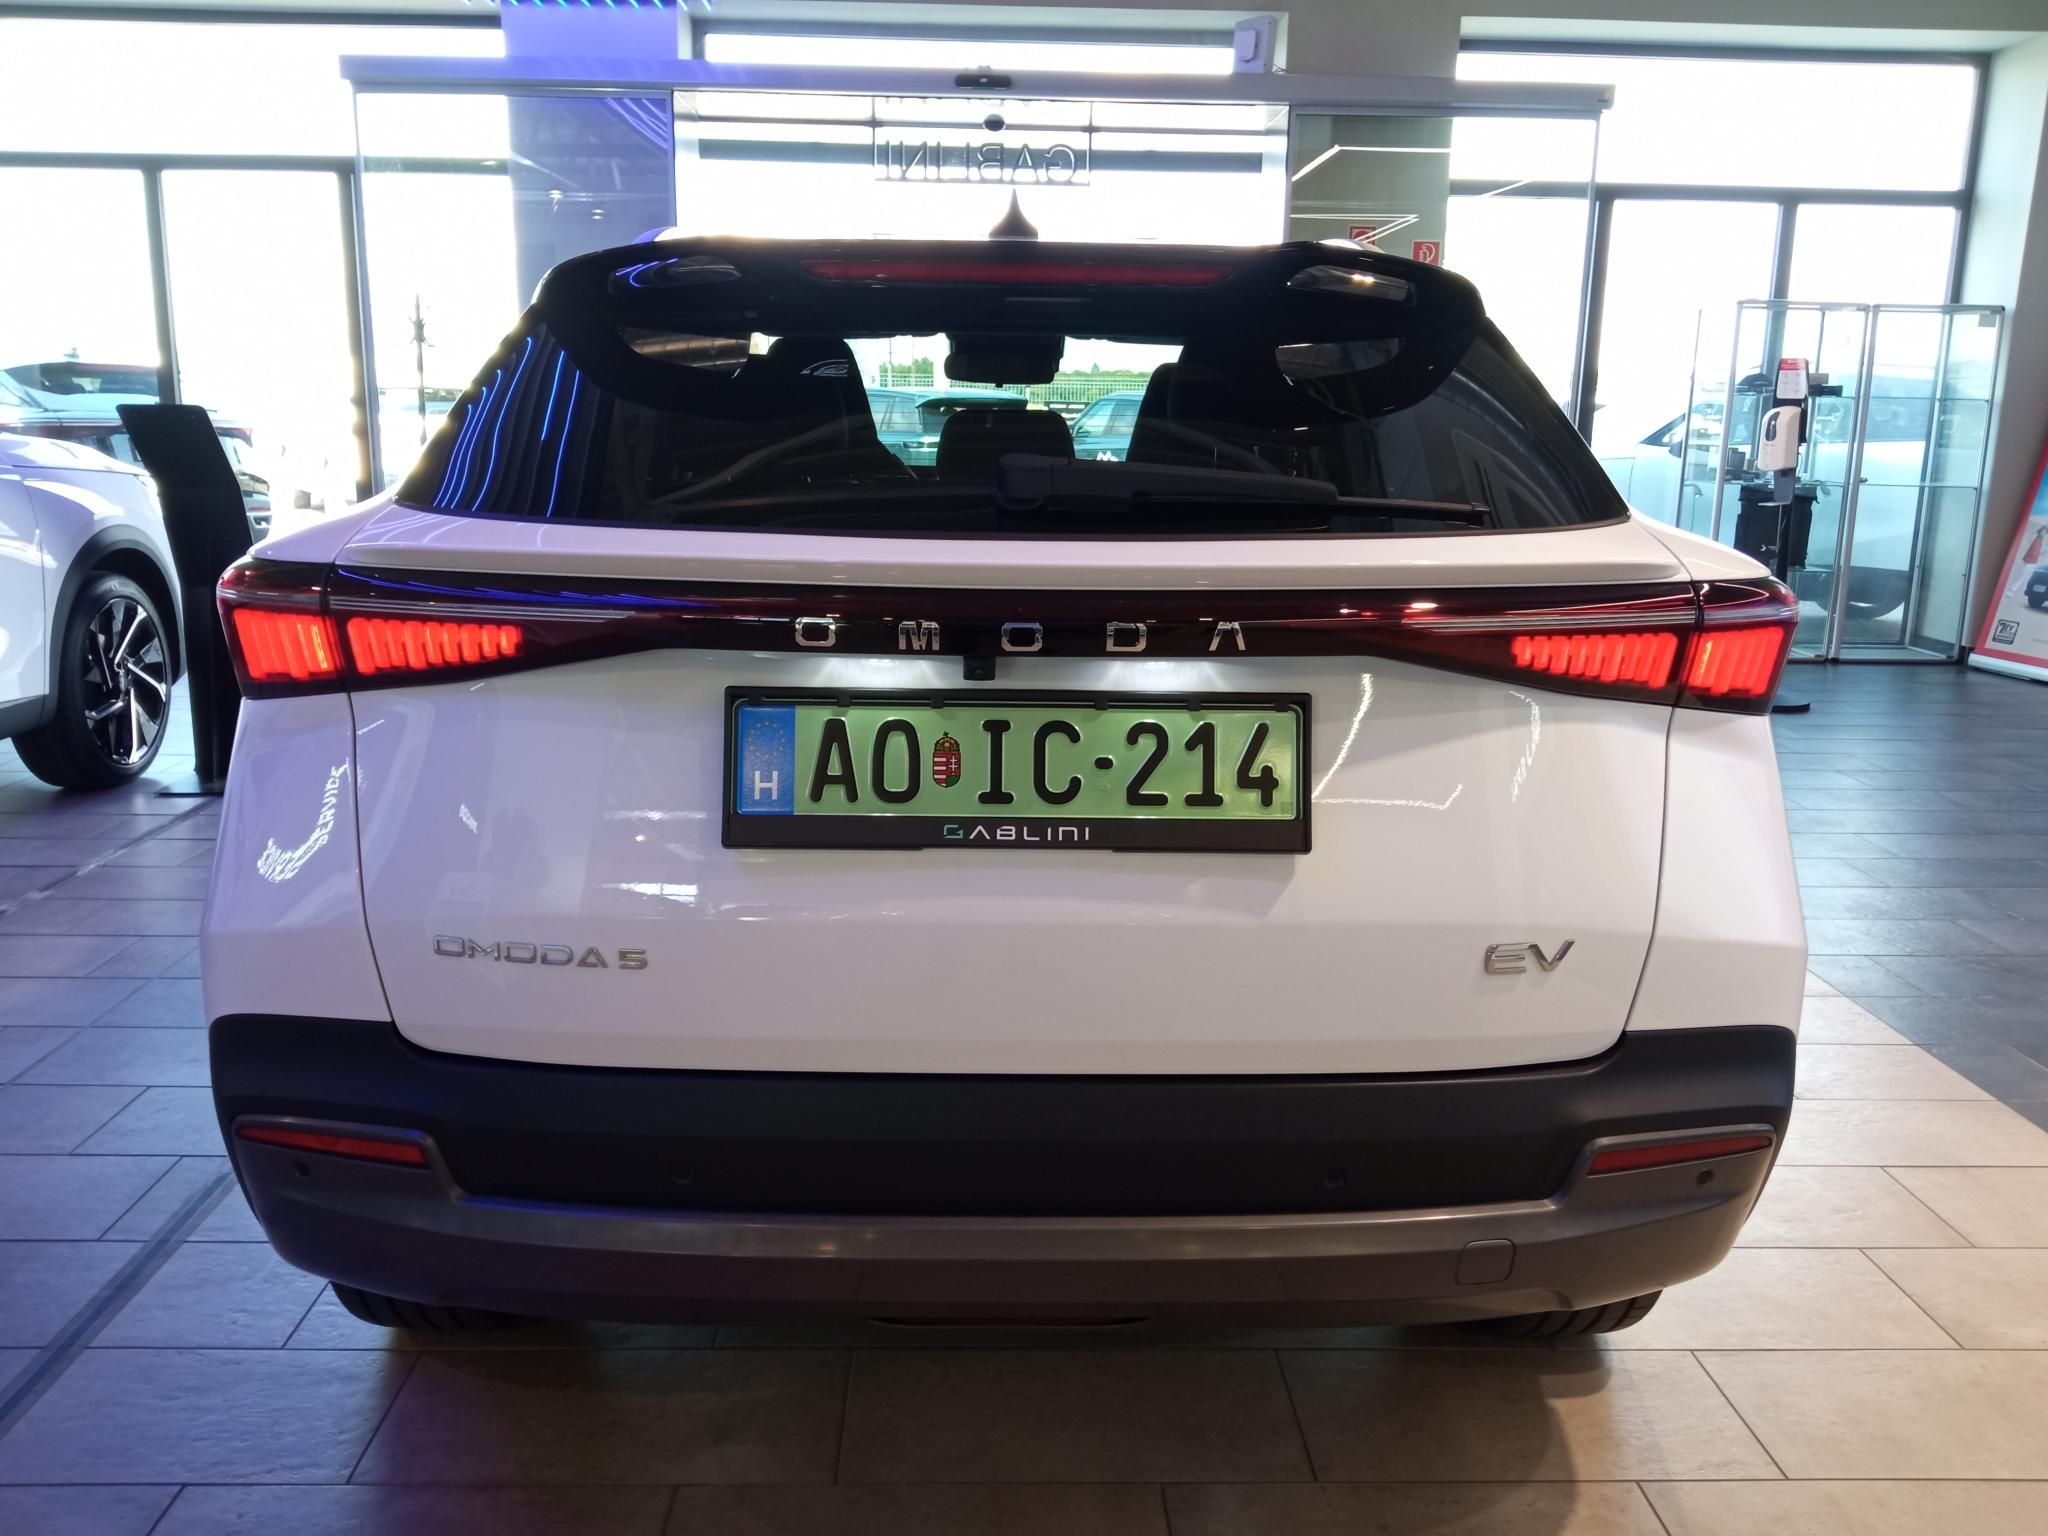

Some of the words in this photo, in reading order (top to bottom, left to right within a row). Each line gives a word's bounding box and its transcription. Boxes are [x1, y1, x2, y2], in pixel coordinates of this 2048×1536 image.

[795, 616, 1247, 652] OMODA
[809, 717, 921, 804] AO
[977, 719, 1280, 808] IC-214
[753, 770, 779, 800] H
[943, 824, 1090, 841] GABLINI
[433, 934, 609, 969] OMODA
[618, 948, 649, 970] 5
[1484, 939, 1576, 976] EV
